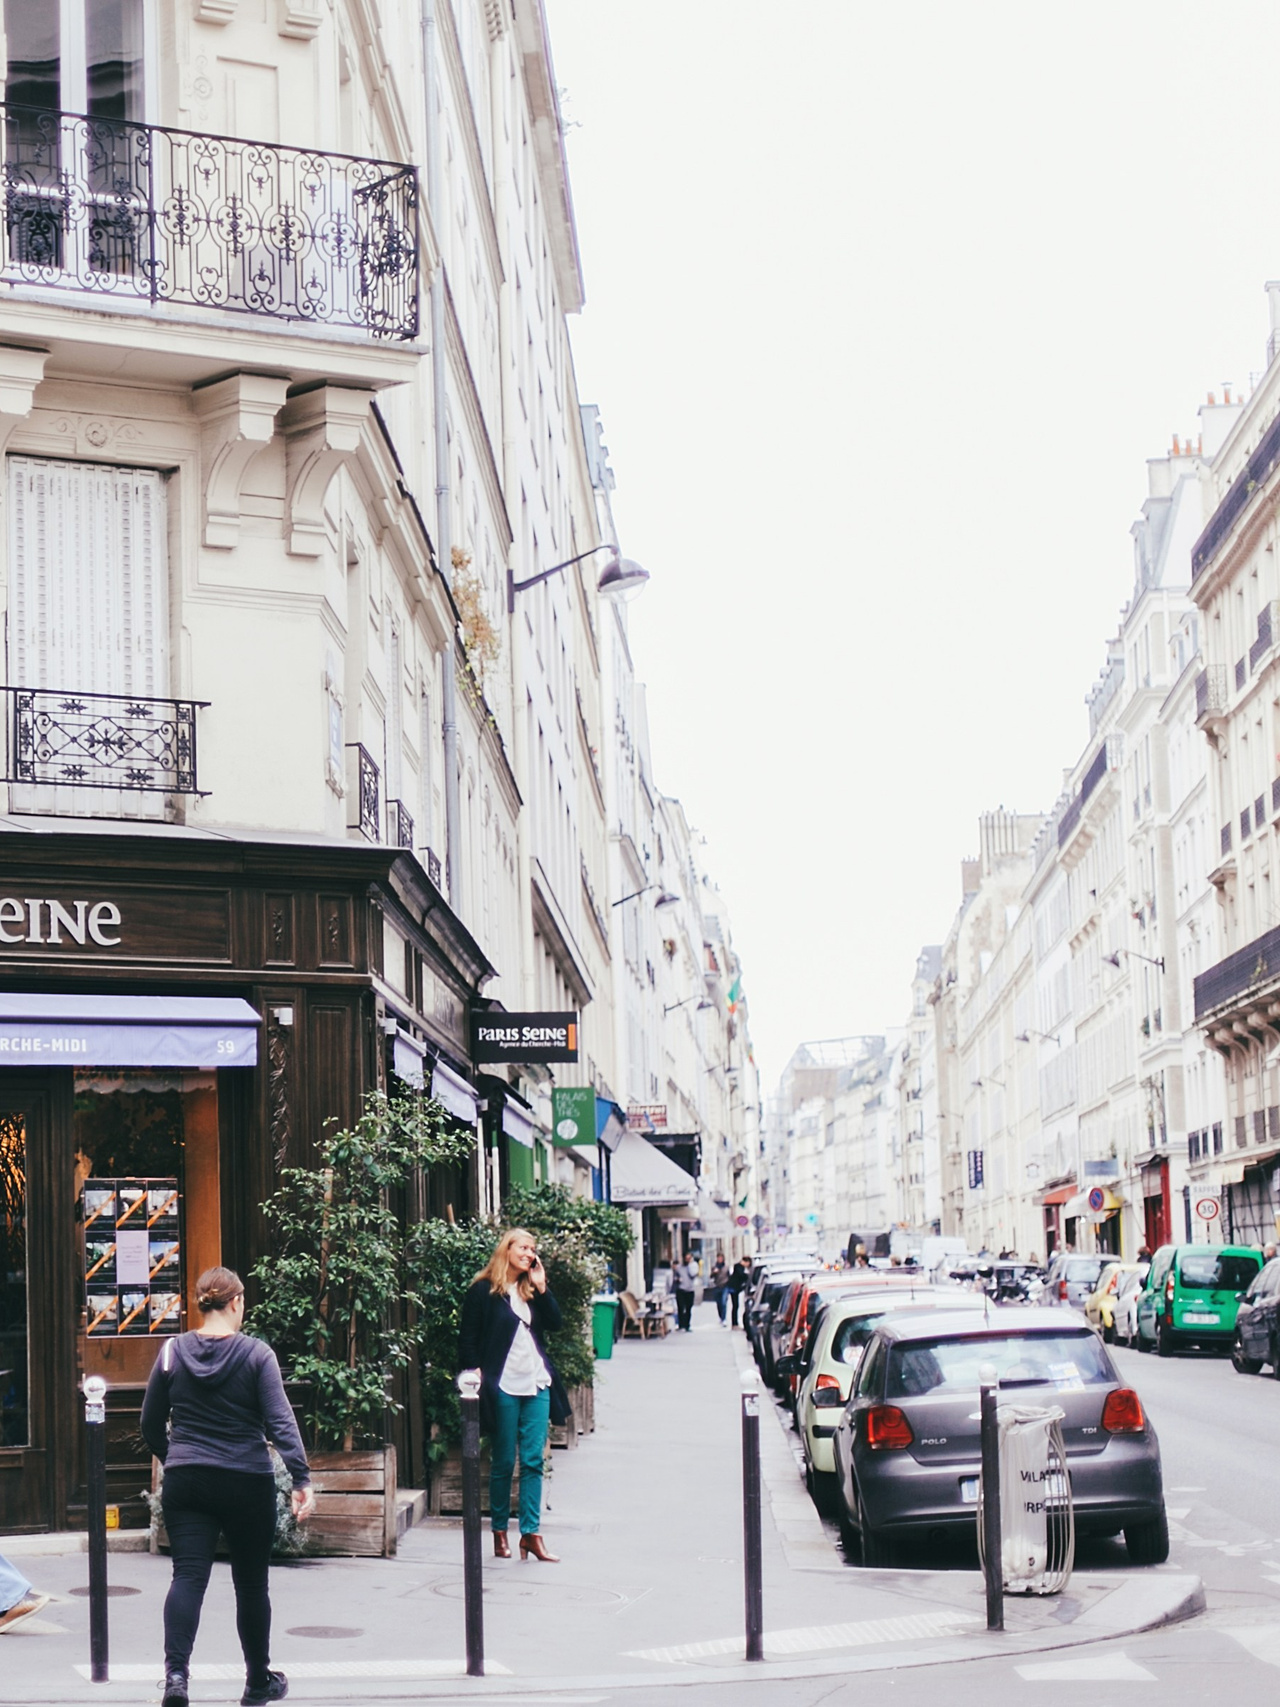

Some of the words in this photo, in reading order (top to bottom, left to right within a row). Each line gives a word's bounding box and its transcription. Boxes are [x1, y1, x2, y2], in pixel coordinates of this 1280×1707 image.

[217, 1040, 235, 1054] 59
[556, 1091, 587, 1101] PALAIS
[1201, 1204, 1214, 1214] 30
[1020, 1470, 1047, 1482] VILA
